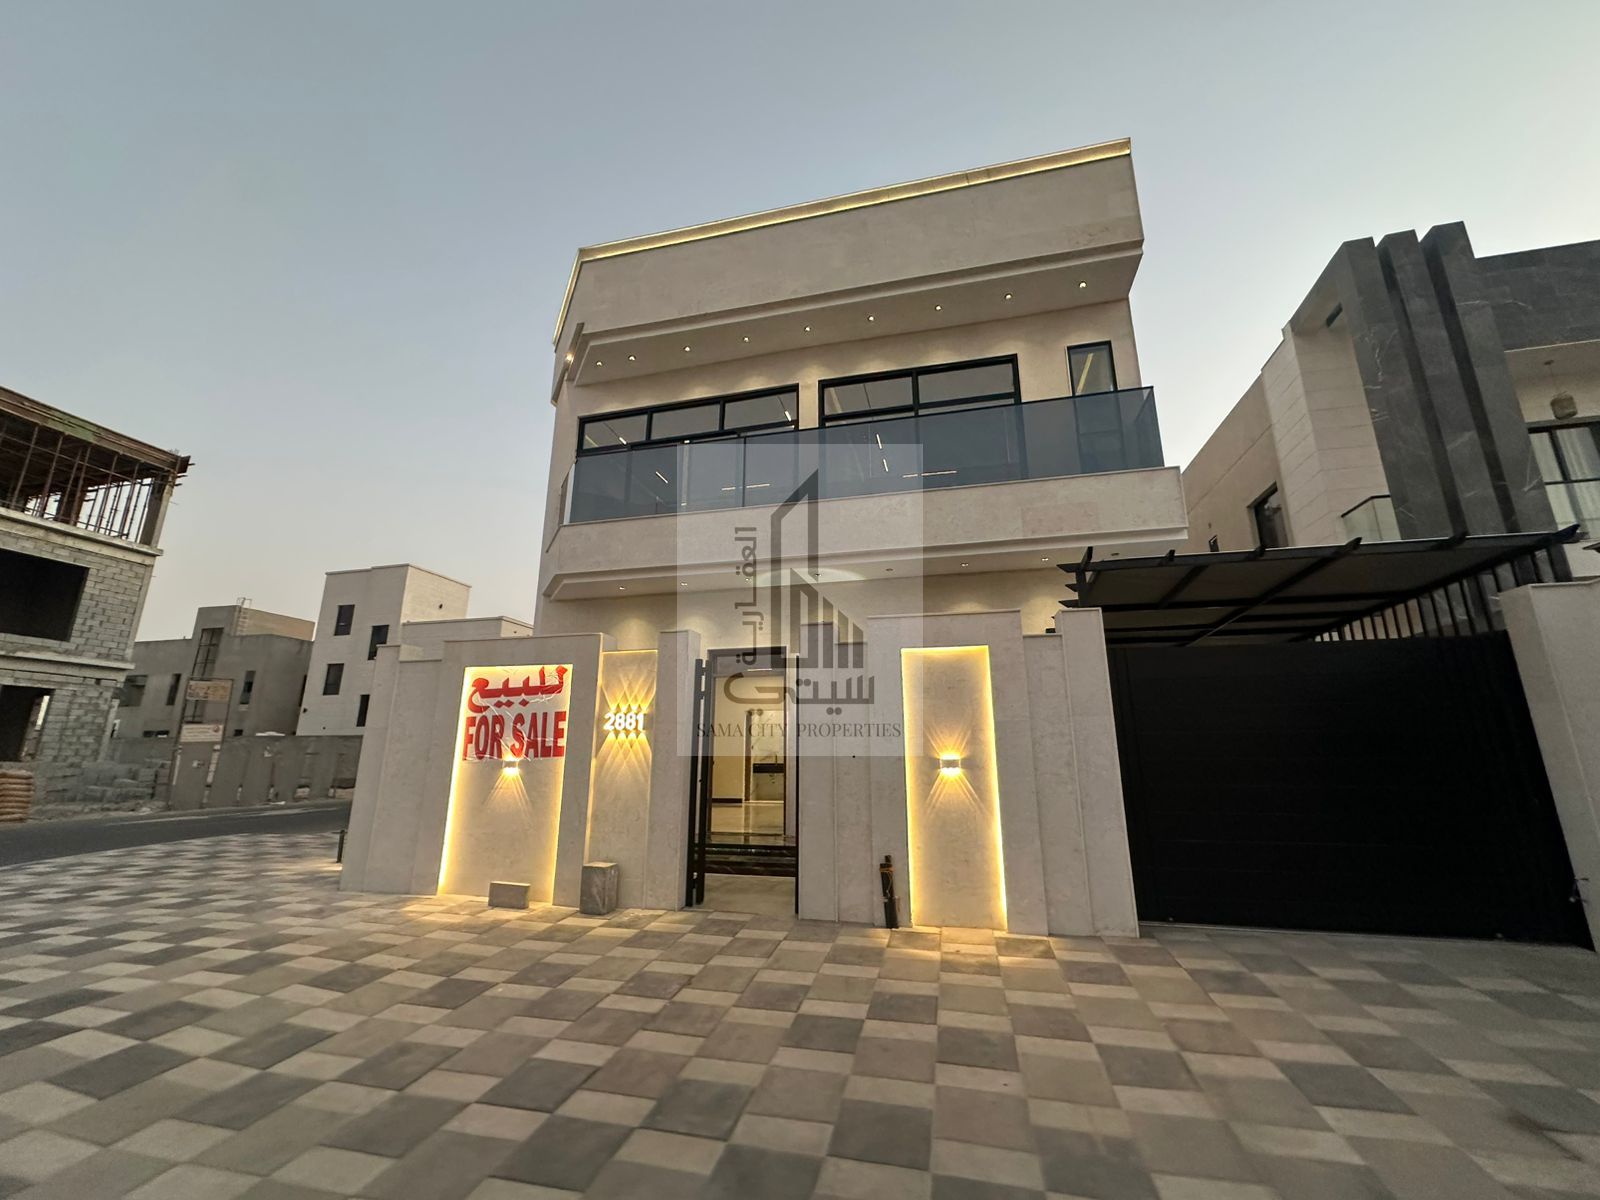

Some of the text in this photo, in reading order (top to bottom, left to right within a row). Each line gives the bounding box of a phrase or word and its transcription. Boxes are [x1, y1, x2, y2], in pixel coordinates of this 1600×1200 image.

[467, 664, 568, 713] للبيع
[462, 711, 567, 761] FOR SALE
[603, 712, 645, 731] 2881
